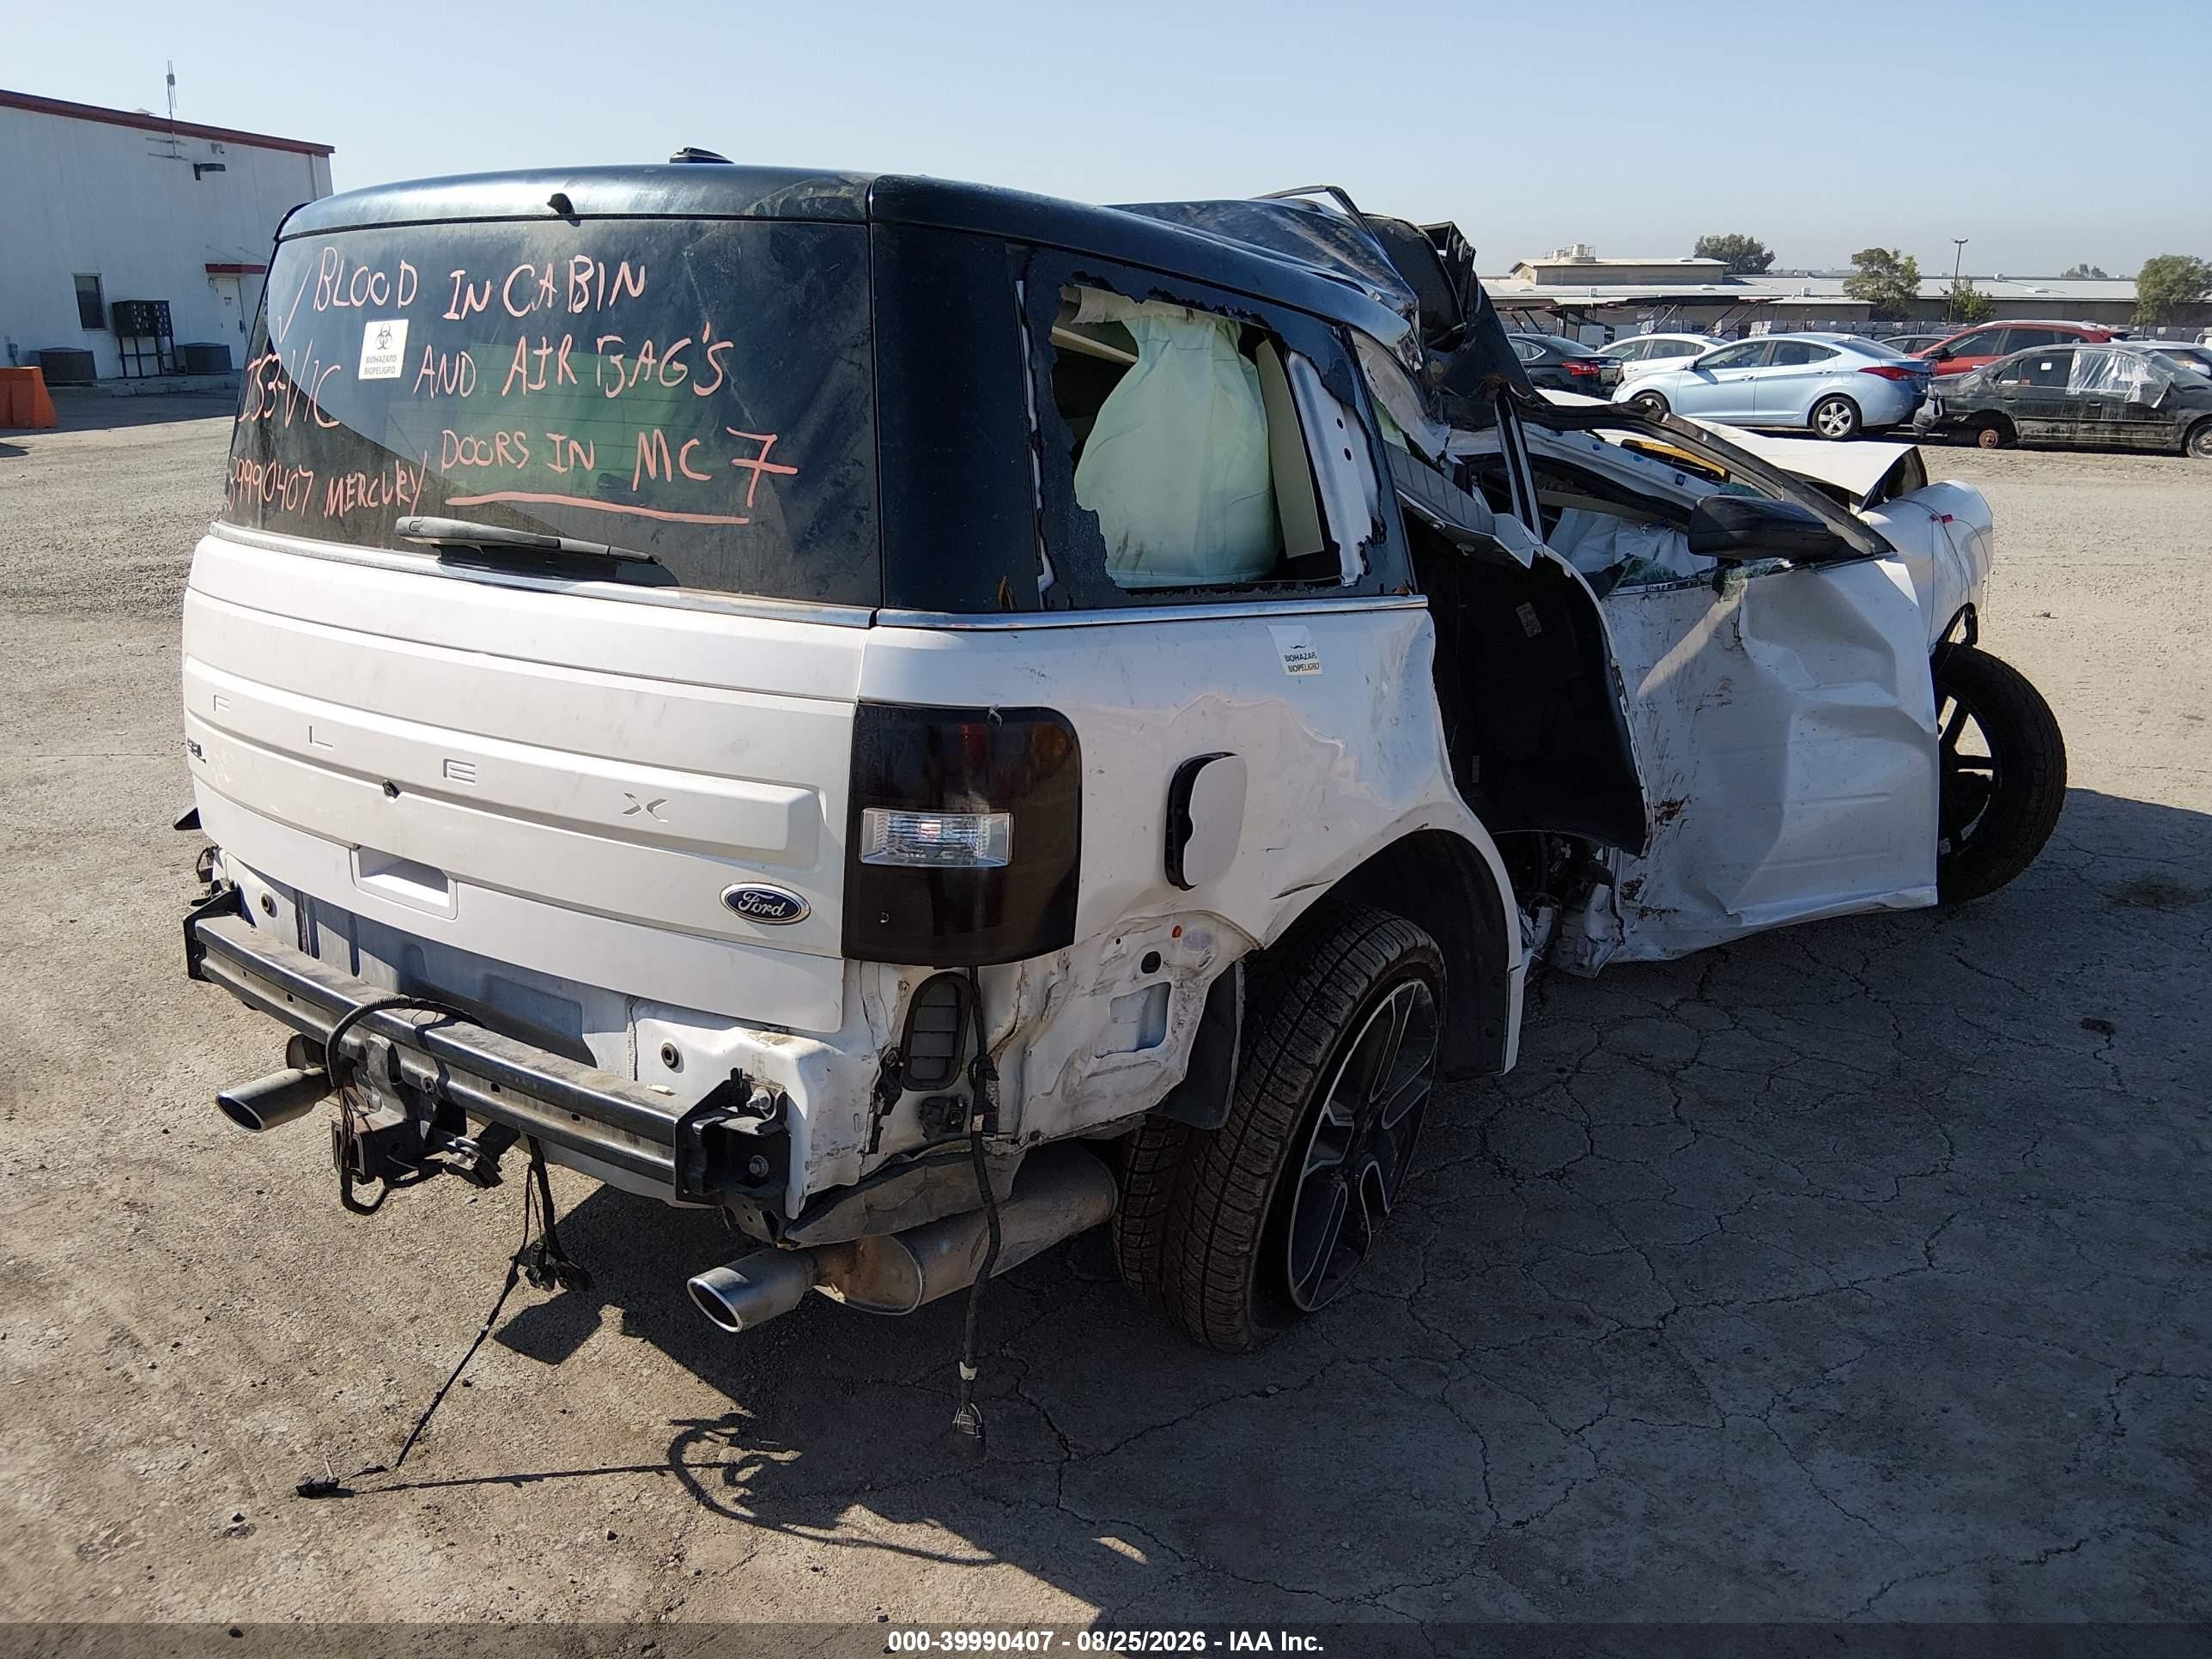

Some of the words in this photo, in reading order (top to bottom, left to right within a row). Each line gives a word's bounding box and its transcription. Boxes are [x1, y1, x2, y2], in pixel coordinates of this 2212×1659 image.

[313, 246, 418, 311] BLOOD
[442, 269, 491, 320] IN
[503, 254, 645, 317] CABIN
[364, 366, 395, 375] BIOPELIGRO
[365, 355, 397, 364] BIOHAZARD
[413, 343, 477, 398] AND
[502, 333, 577, 396] AIR
[596, 320, 734, 398] BAG'S
[228, 455, 314, 517] 39990407
[324, 449, 428, 519] MERCURY
[441, 429, 530, 474] DOORS
[546, 432, 594, 475] IN
[632, 428, 712, 491] MC
[726, 426, 798, 508] 7
[213, 693, 670, 823] FLEX
[738, 891, 787, 916] Ford
